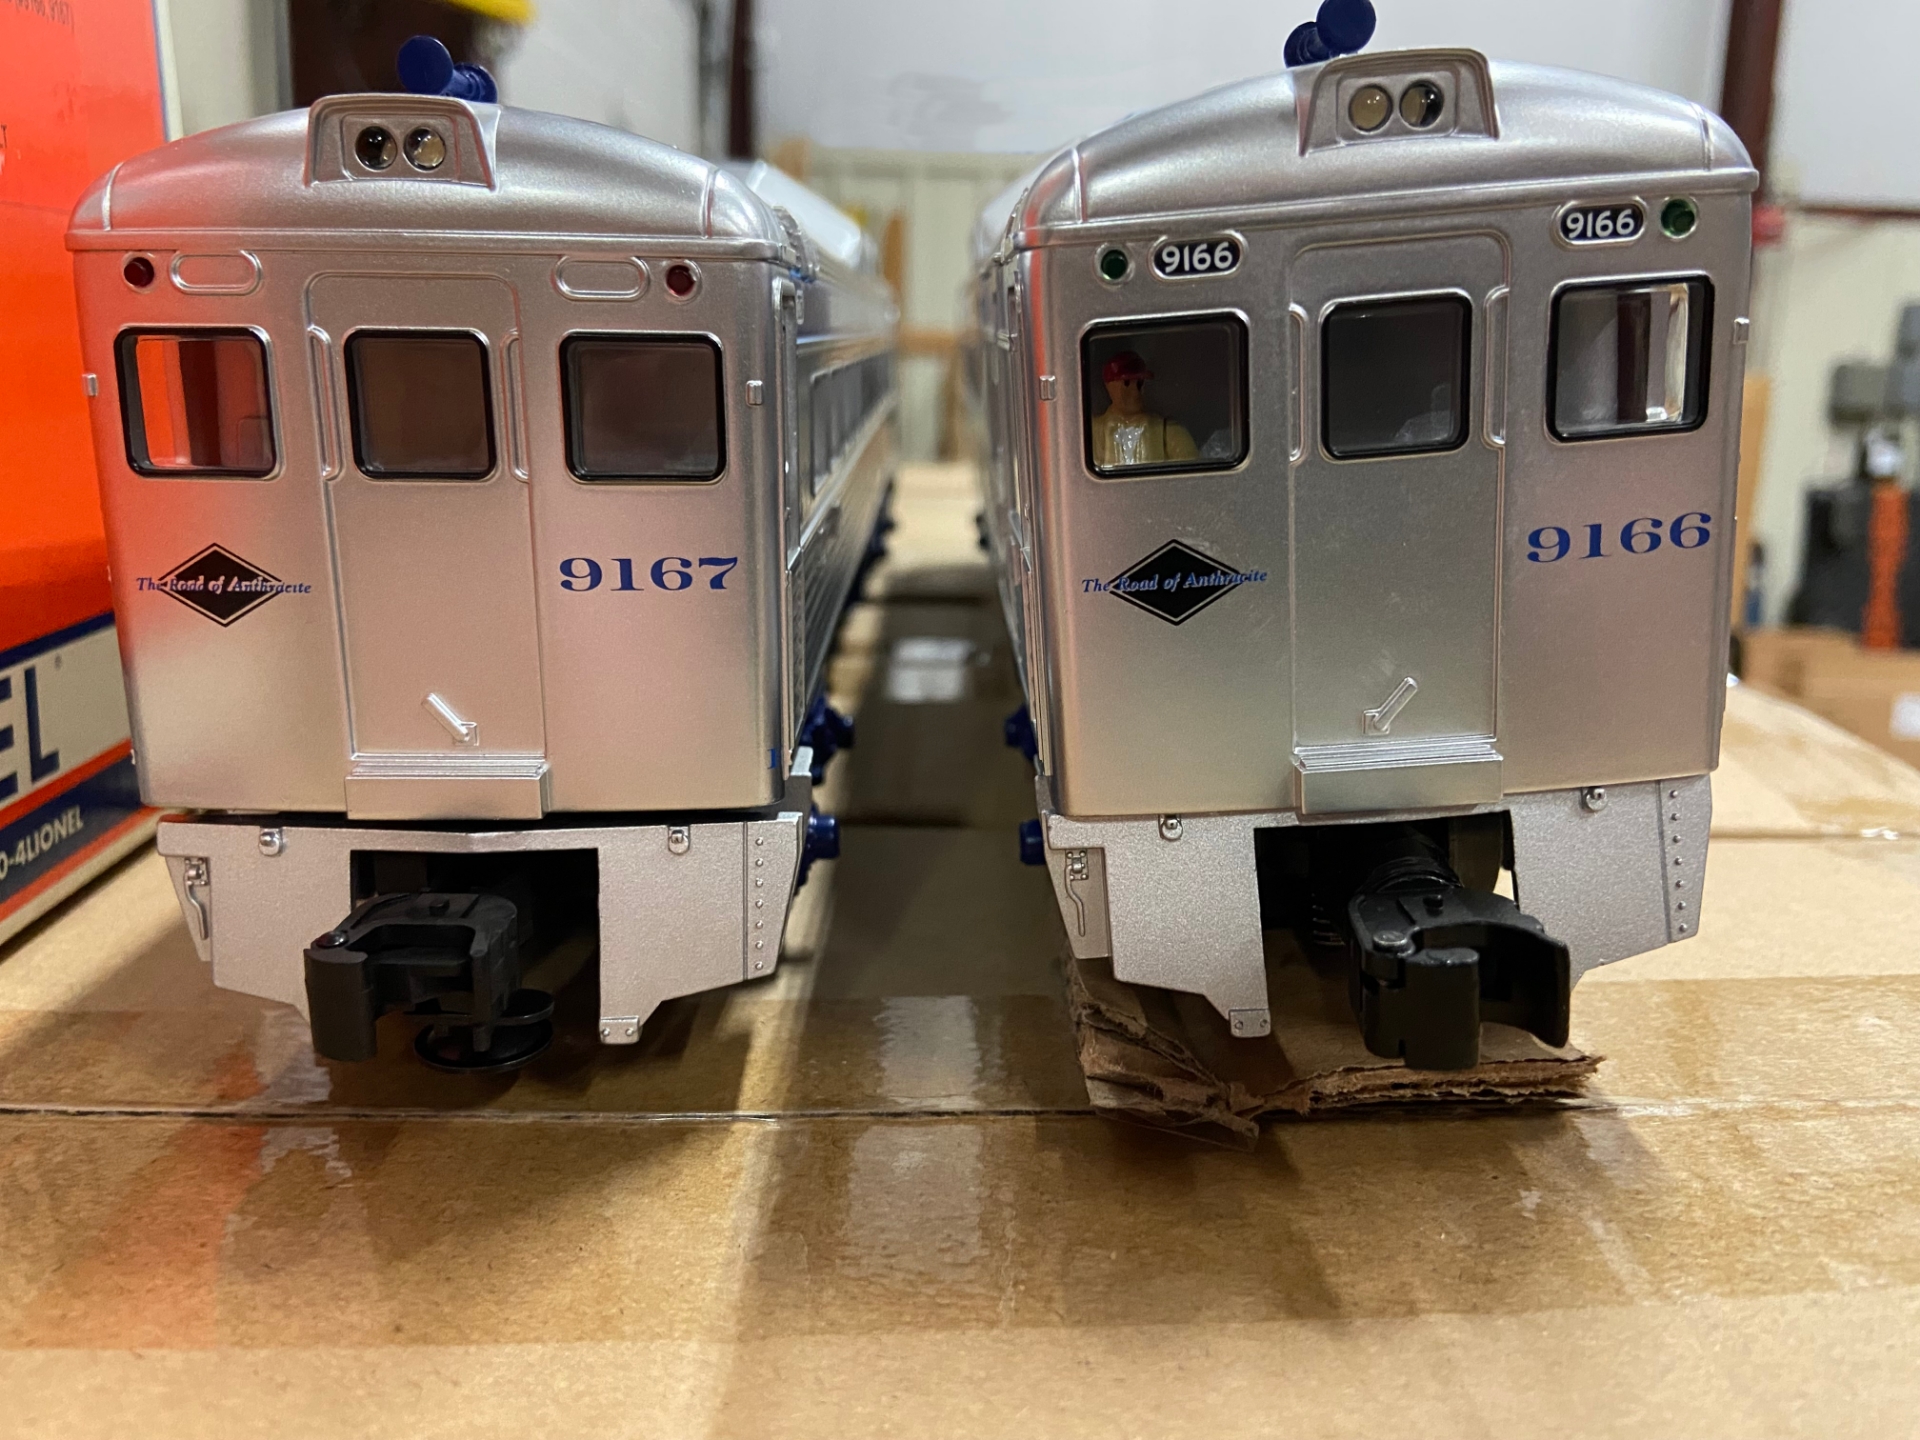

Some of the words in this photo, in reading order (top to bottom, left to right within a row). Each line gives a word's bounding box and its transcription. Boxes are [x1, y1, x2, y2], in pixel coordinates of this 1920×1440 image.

[1566, 208, 1635, 239] 9166
[1161, 241, 1233, 274] 9166
[1526, 511, 1712, 563] 9166
[136, 577, 163, 592] The
[169, 575, 205, 592] Road
[208, 575, 226, 595] of
[227, 576, 312, 594] Anthracite
[559, 556, 738, 592] 9167
[1081, 578, 1111, 593] The
[1117, 573, 1159, 592] Road
[1163, 572, 1181, 592] of
[1182, 569, 1268, 589] Anthracite
